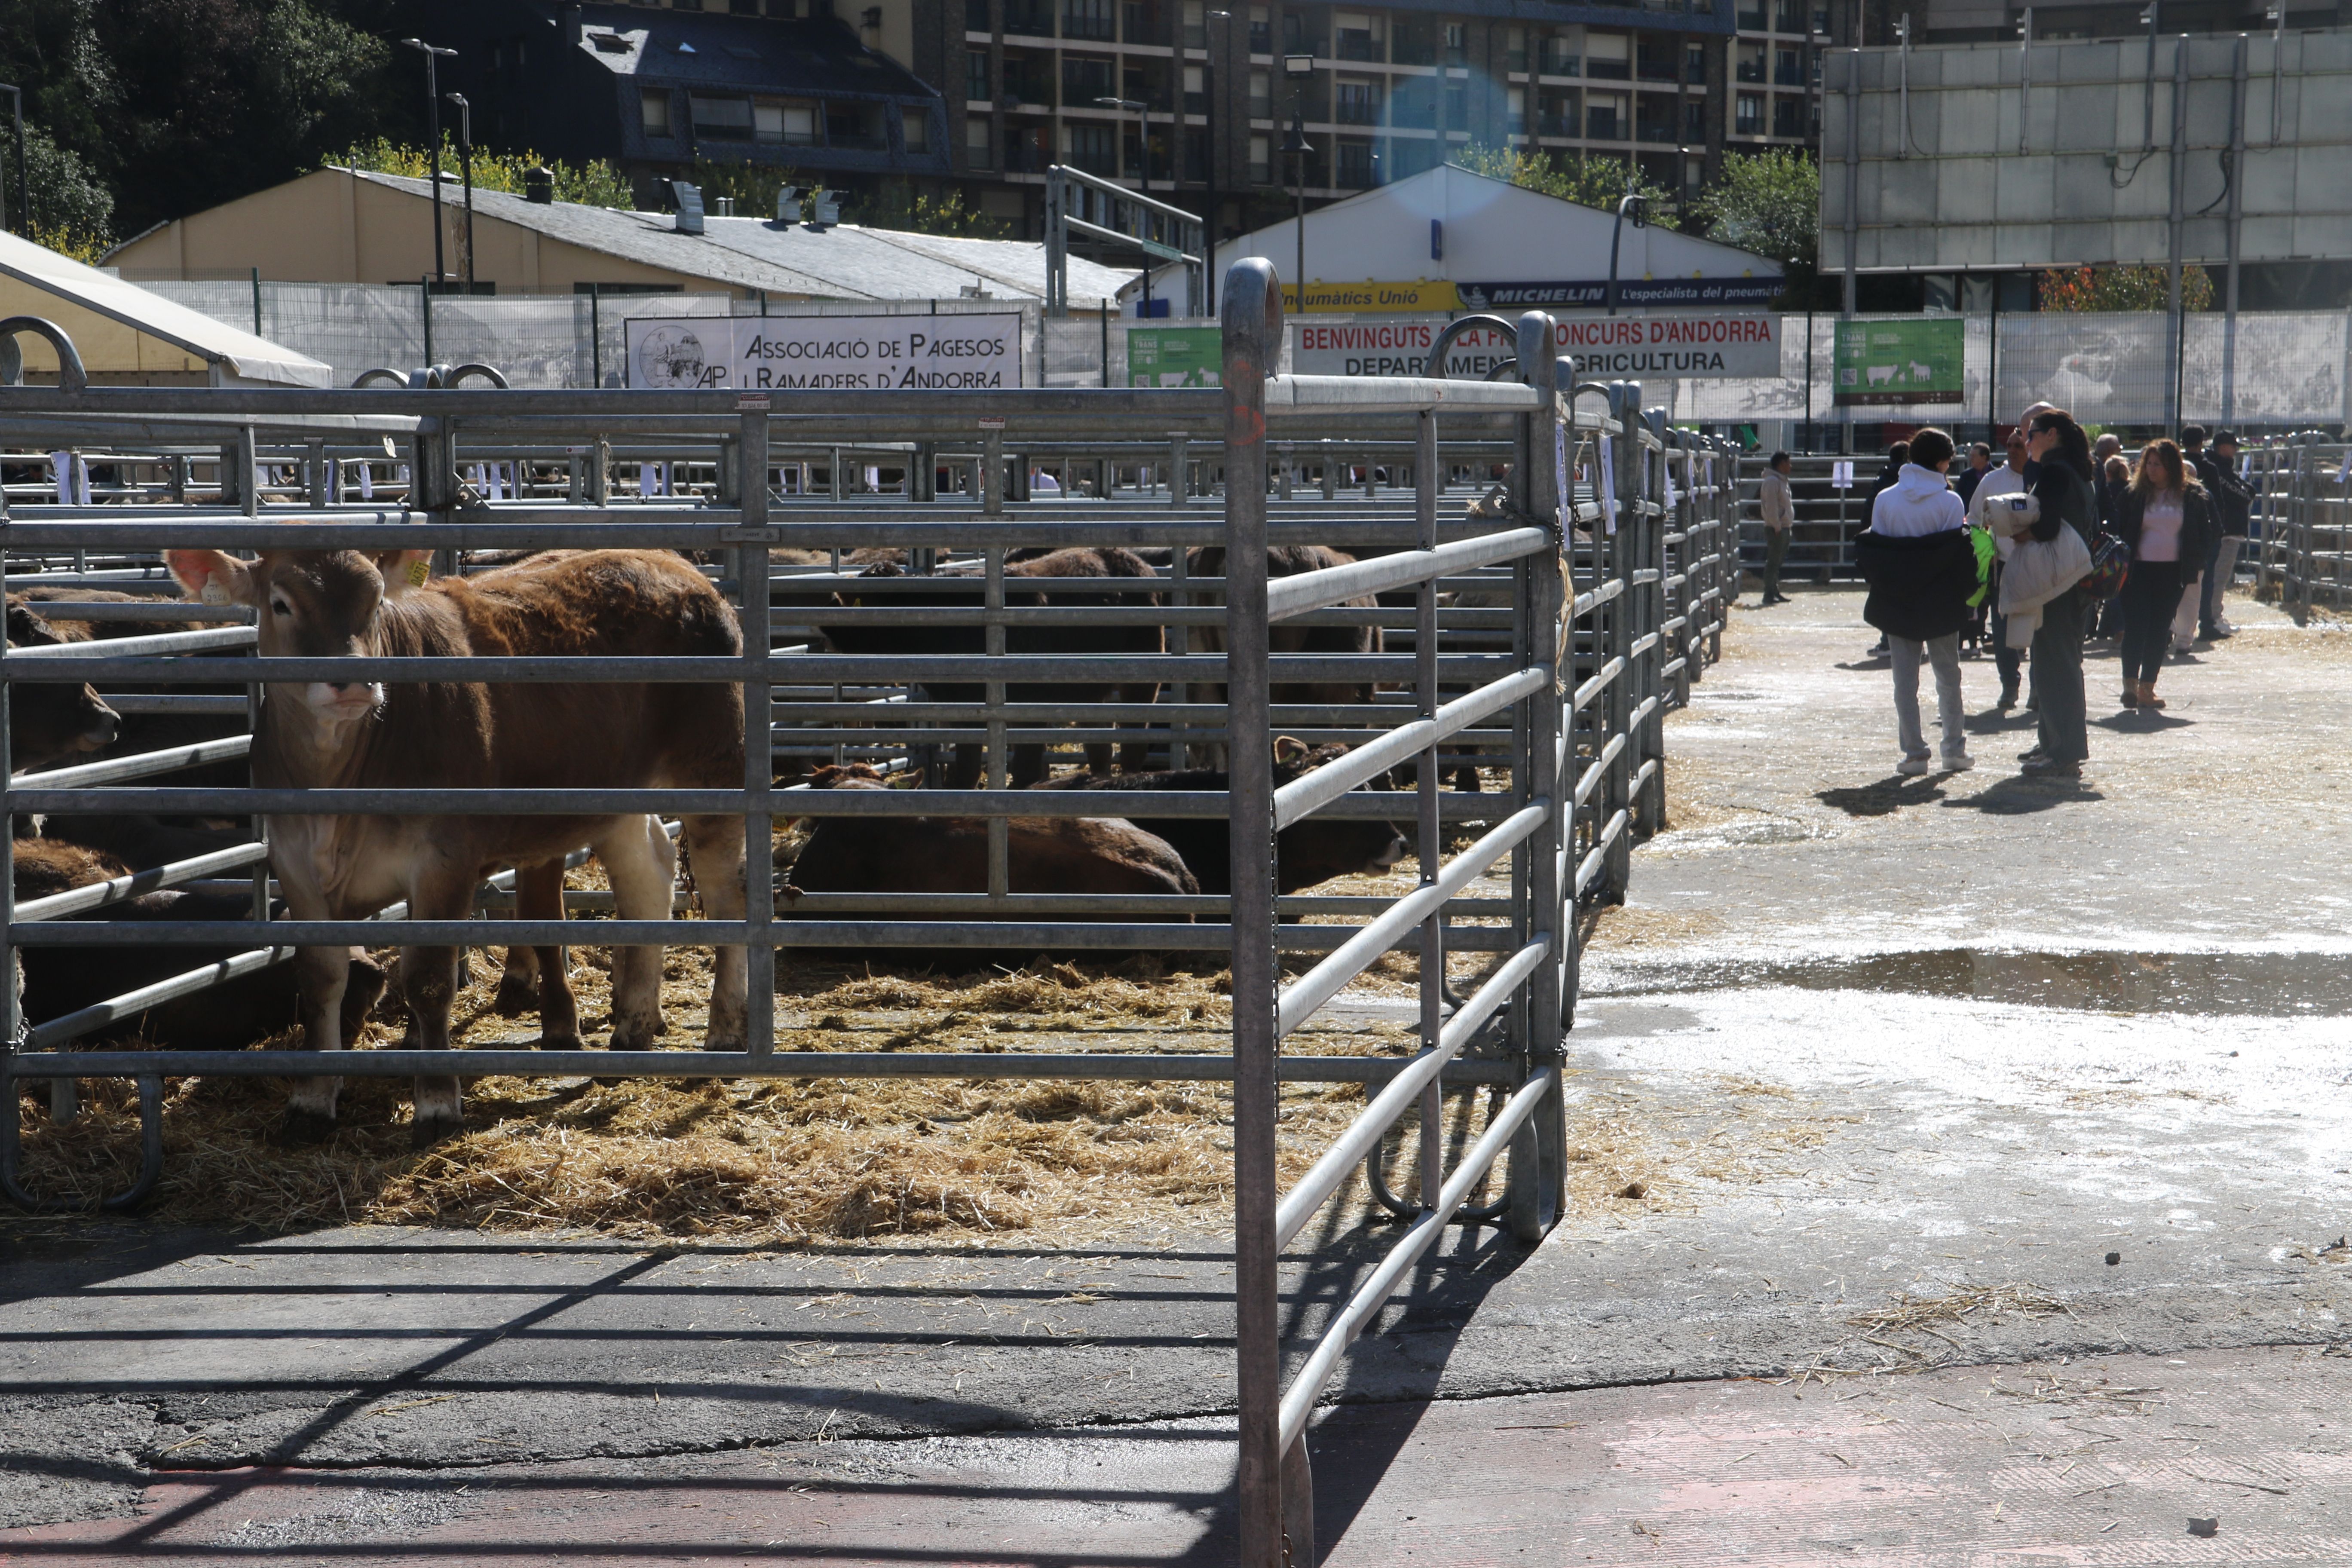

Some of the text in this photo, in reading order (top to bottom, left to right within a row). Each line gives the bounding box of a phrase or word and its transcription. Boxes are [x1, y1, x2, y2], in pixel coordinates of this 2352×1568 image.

[1379, 290, 1418, 304] Unió
[1492, 288, 1604, 302] MICHELIN
[1622, 288, 1697, 301] L'especialista
[1703, 287, 1721, 297] del
[1303, 326, 1431, 349] BENVINGUTS
[1651, 320, 1771, 343] D'ANDORRA
[1842, 334, 1866, 342] TRANS
[745, 334, 1004, 359] ASSOCIACIÓ DE PAGESOS
[757, 368, 869, 388] RAMADERS
[878, 365, 1001, 388] D'ANDORRA
[411, 562, 429, 585] 06731
